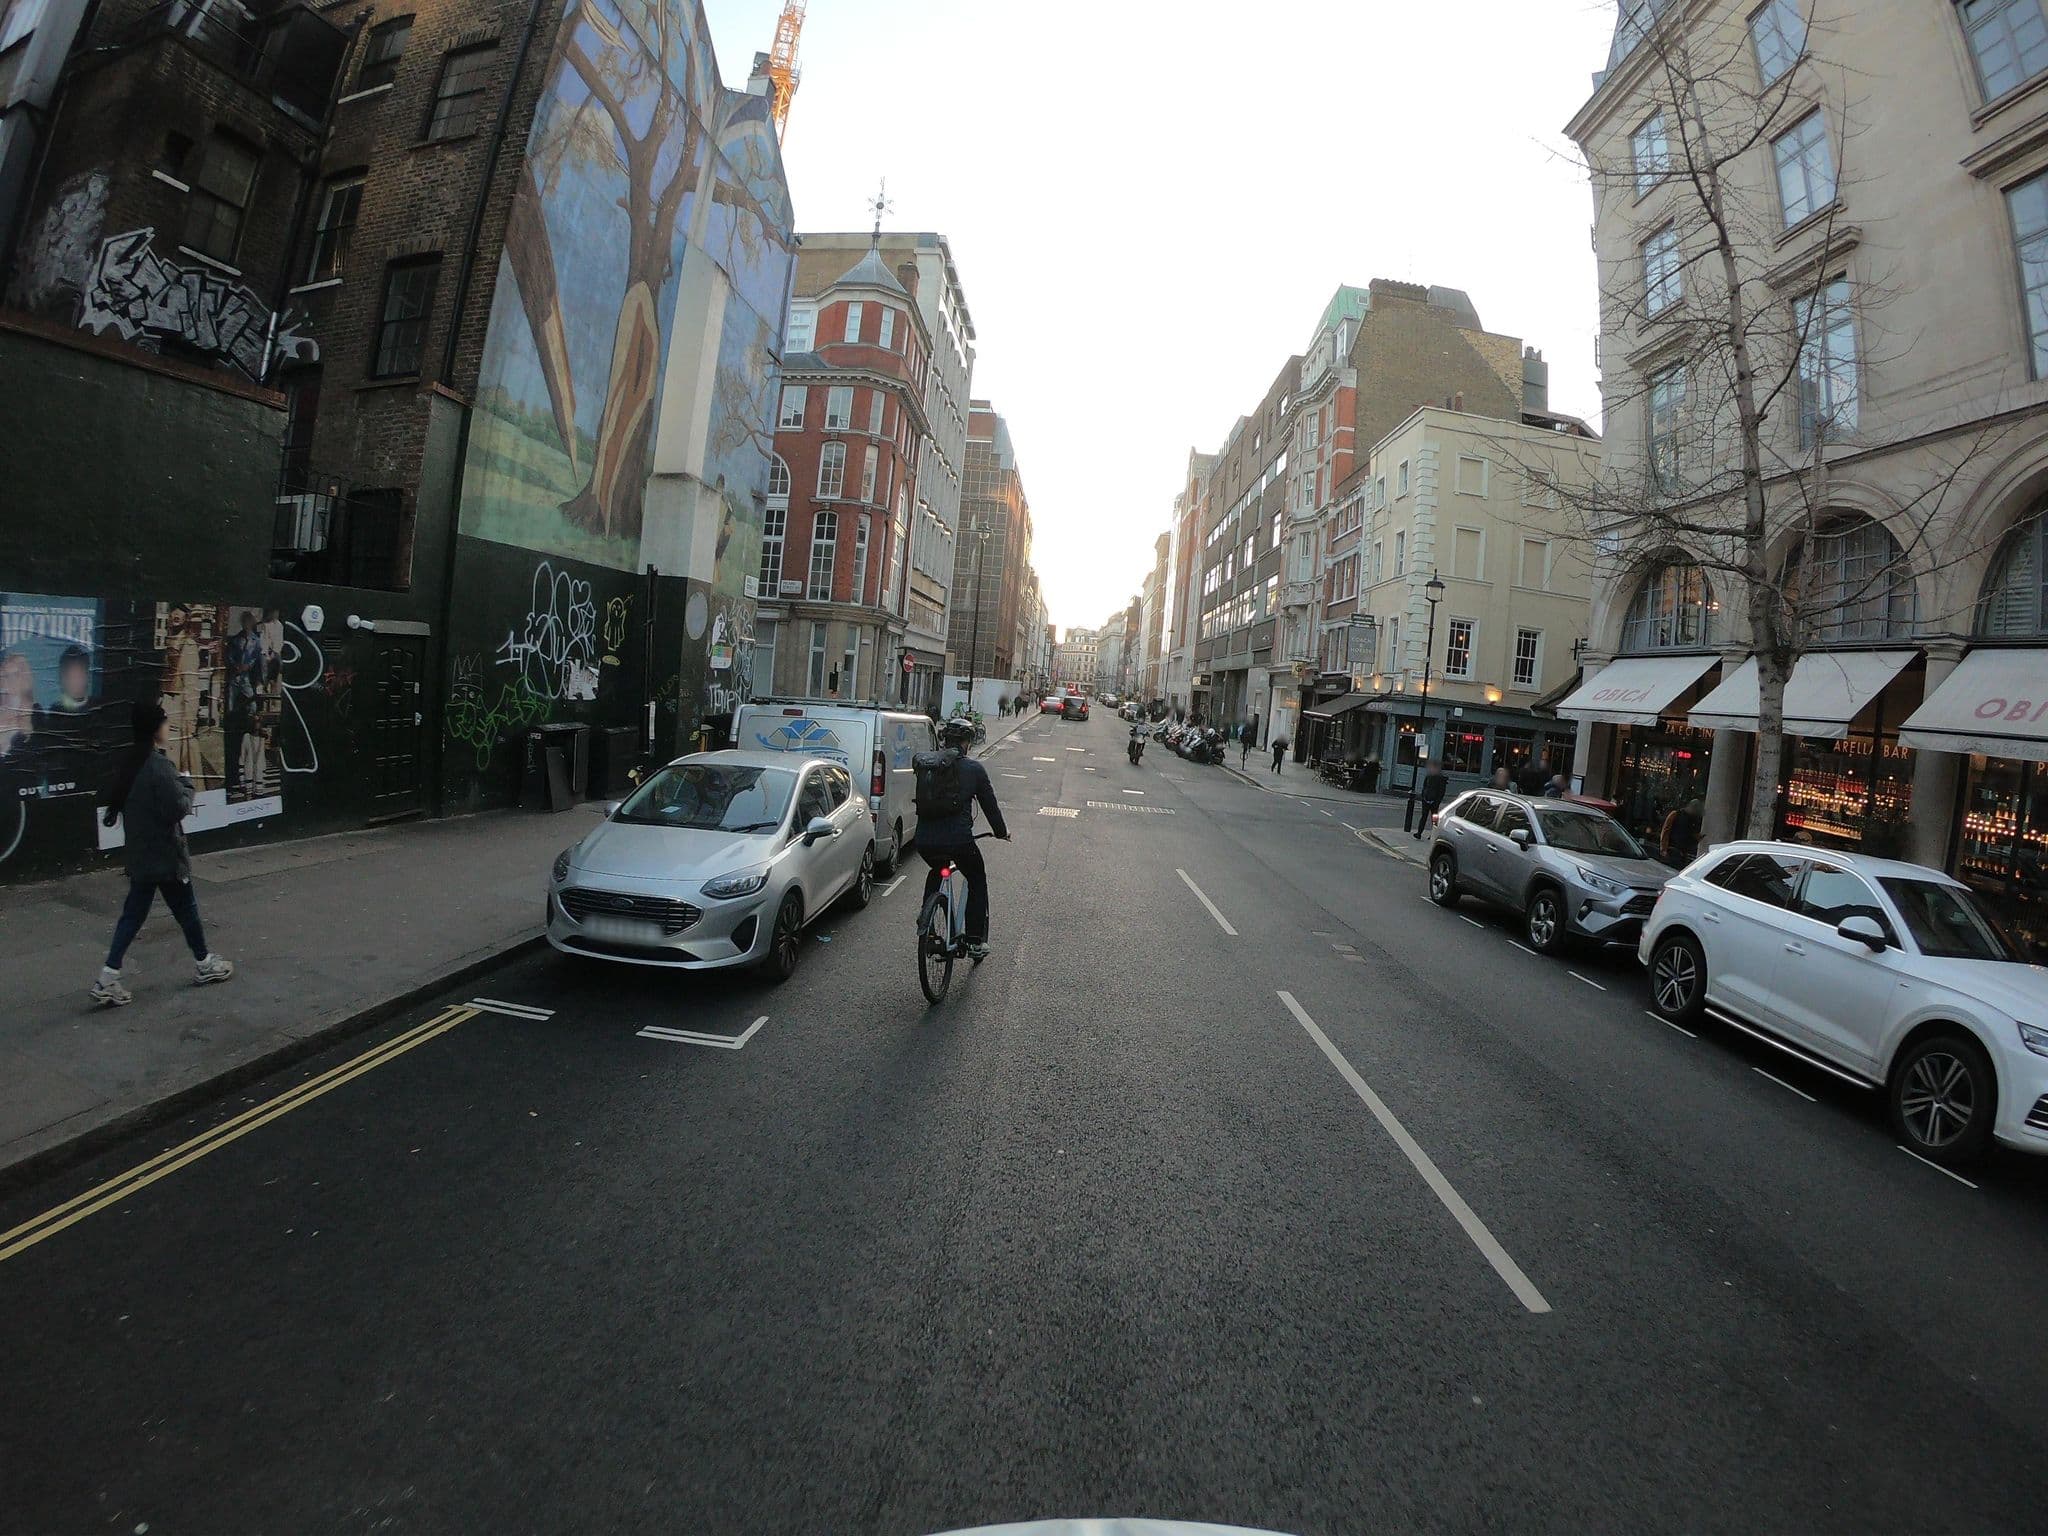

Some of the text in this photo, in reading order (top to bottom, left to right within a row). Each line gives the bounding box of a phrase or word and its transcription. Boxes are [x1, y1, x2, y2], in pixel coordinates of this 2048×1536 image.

[1, 612, 94, 648] MOTHER
[1883, 744, 1909, 760] BAR
[18, 782, 77, 797] OUT NOW
[236, 802, 274, 816] GANT
